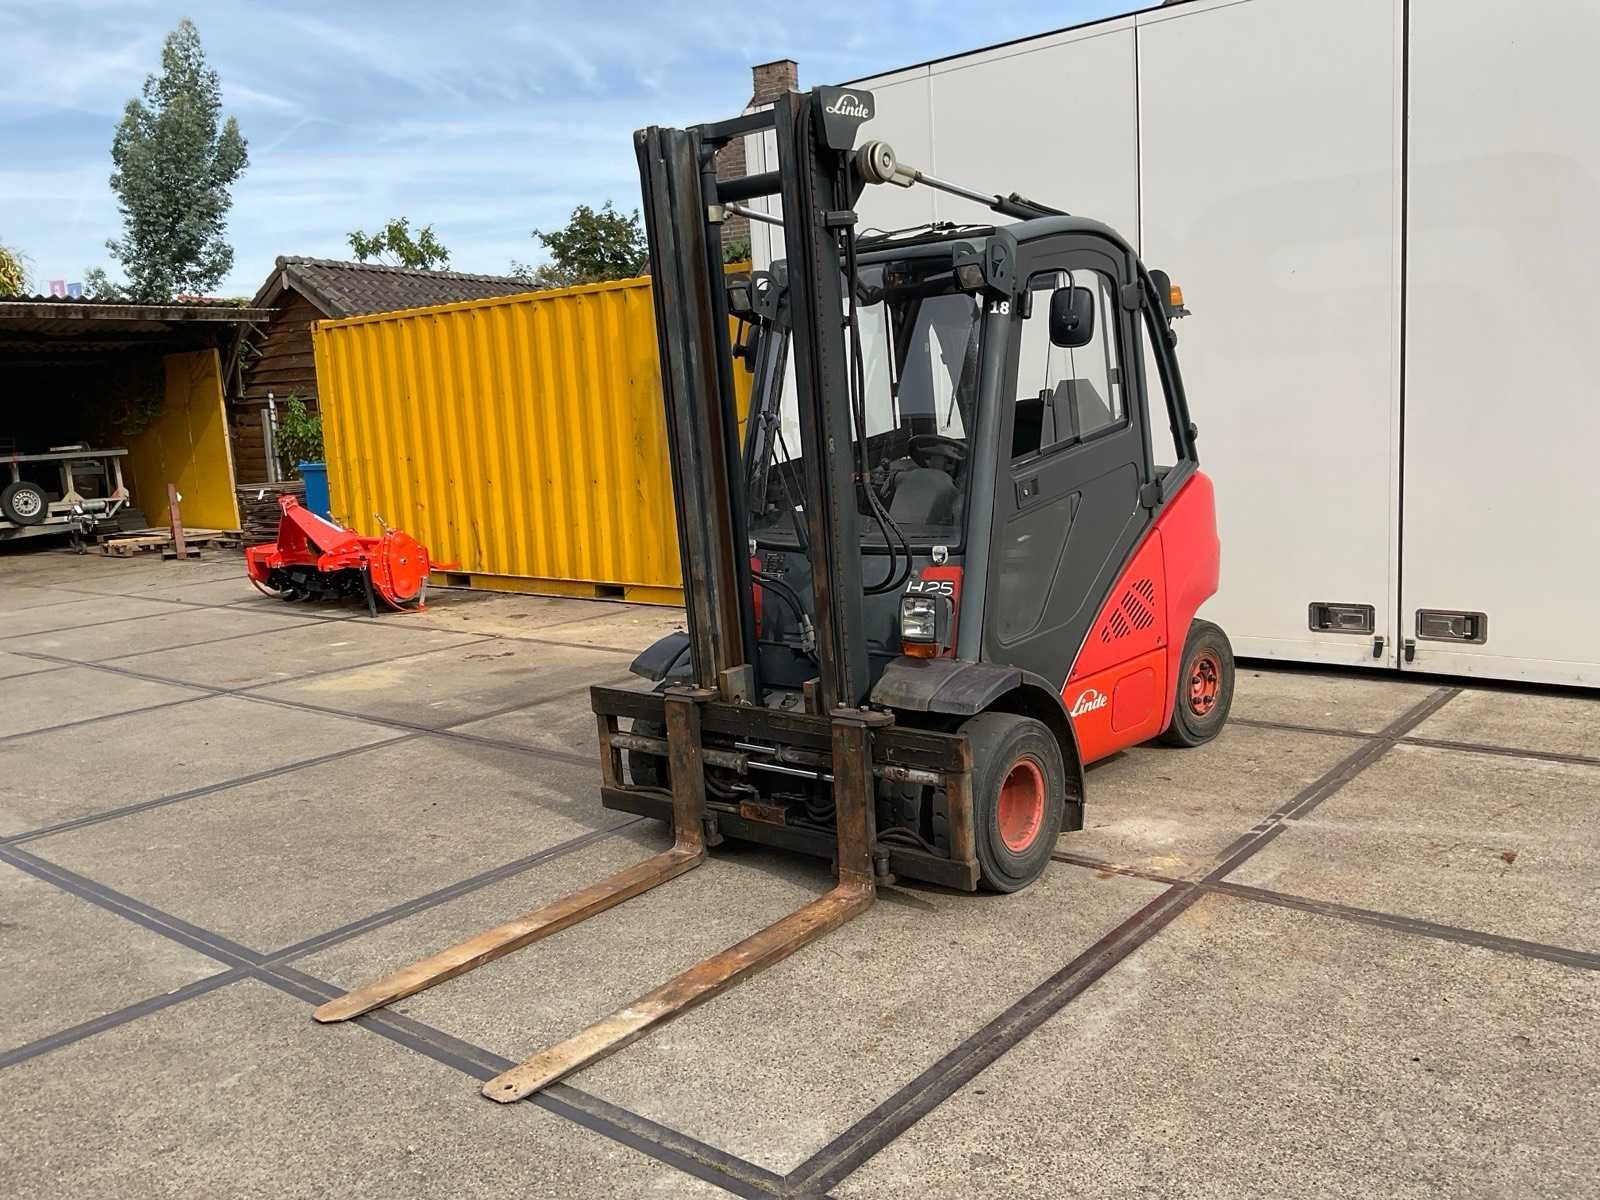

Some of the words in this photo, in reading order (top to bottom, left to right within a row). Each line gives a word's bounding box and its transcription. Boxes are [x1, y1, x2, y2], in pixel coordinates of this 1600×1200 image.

[826, 94, 869, 118] Linde
[990, 300, 1010, 315] 18
[1070, 688, 1108, 718] Linde
